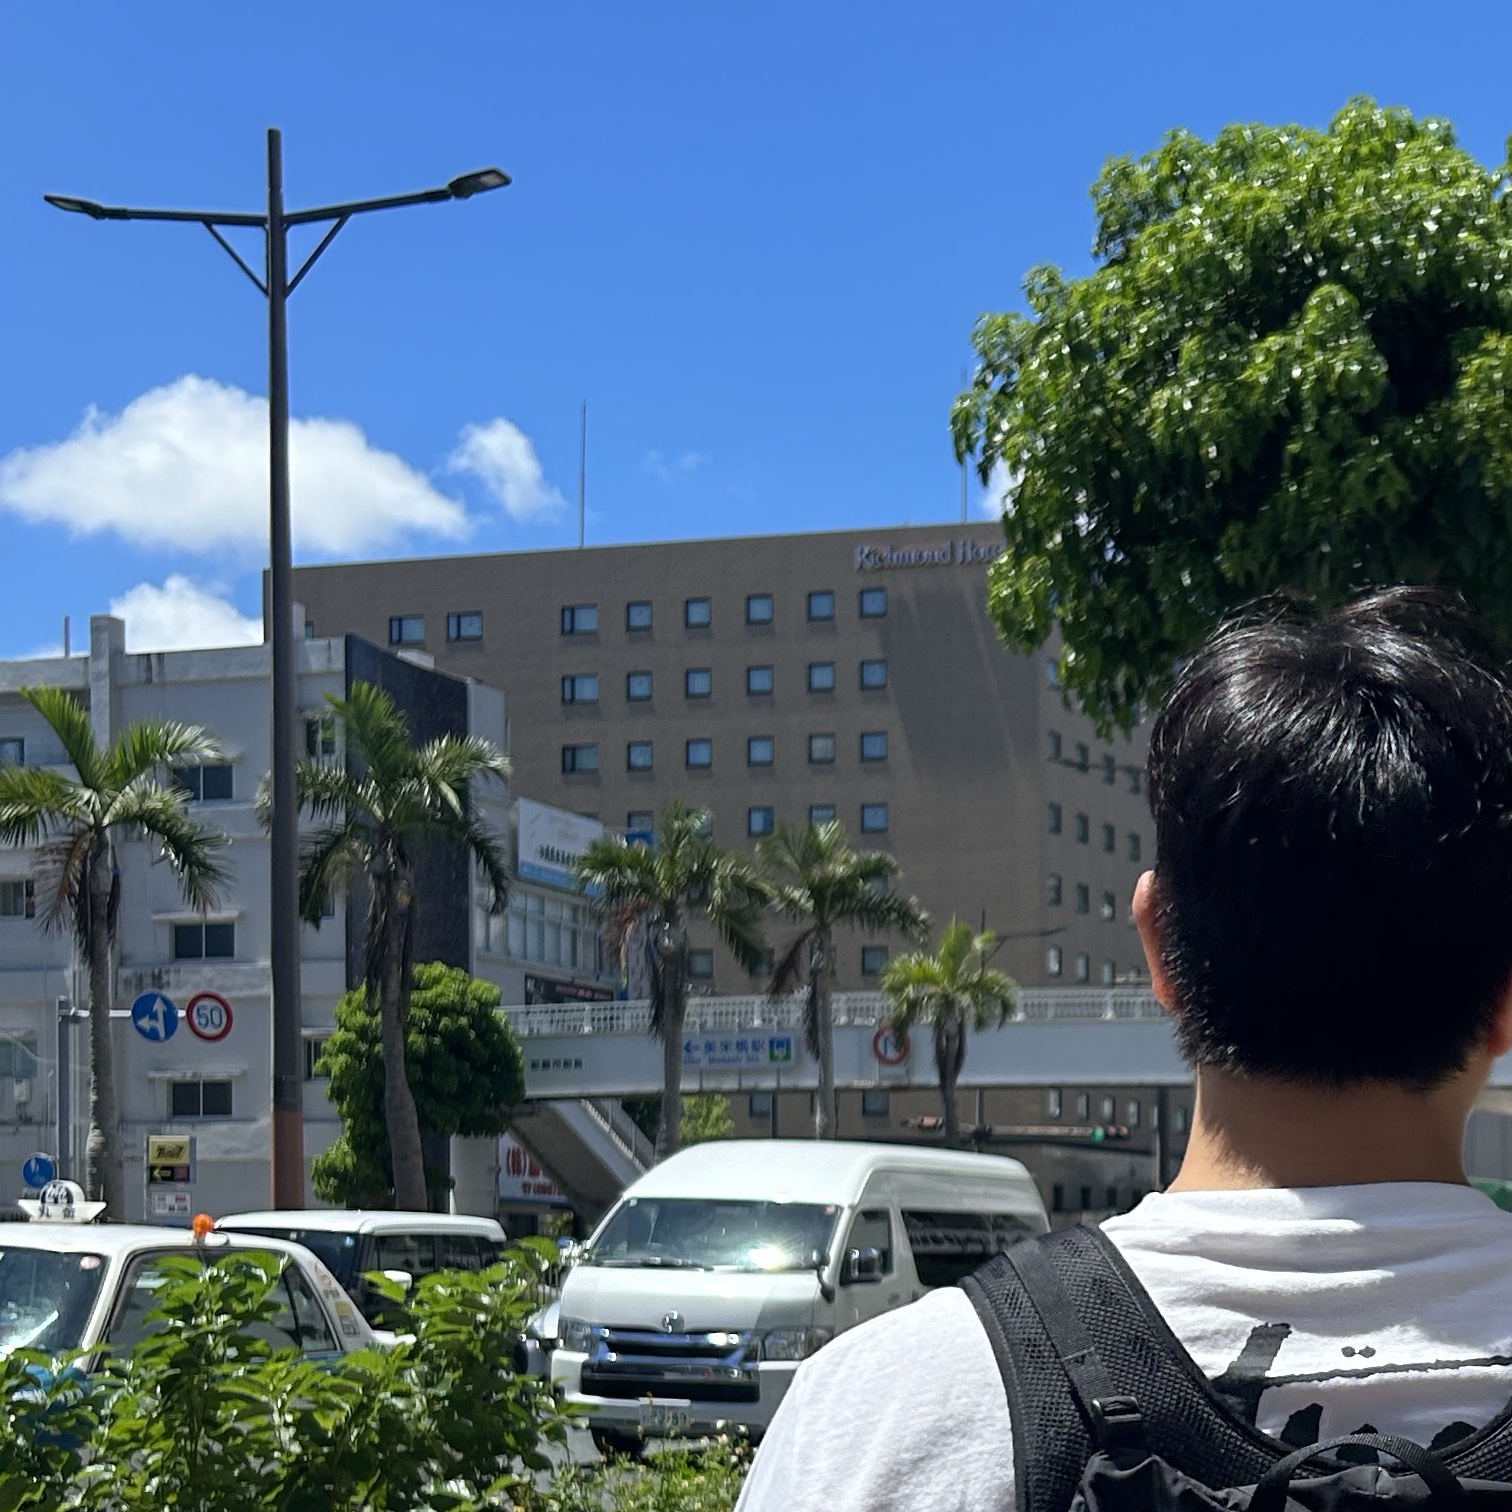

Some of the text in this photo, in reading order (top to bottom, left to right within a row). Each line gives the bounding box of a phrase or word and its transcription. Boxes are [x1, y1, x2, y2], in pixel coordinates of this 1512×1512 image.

[853, 538, 1006, 571] Richmond Hote
[196, 1004, 223, 1029] 50
